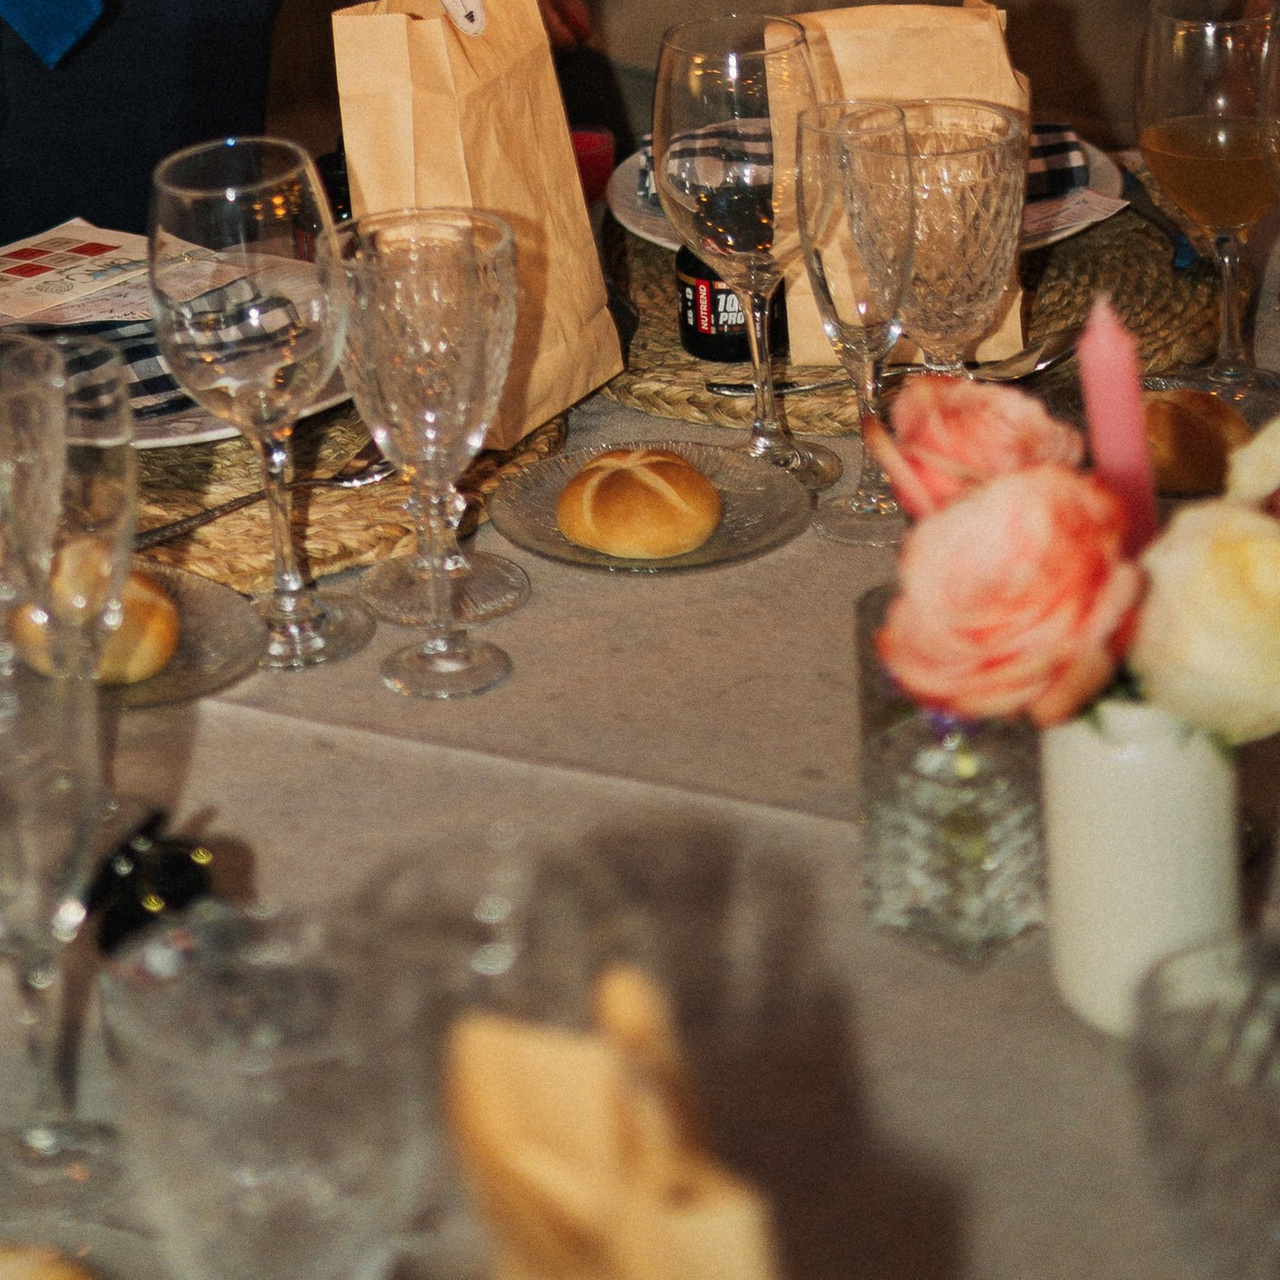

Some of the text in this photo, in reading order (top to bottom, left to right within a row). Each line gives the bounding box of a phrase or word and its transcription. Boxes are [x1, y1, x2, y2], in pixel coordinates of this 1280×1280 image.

[698, 284, 709, 331] NUTREND
[717, 293, 743, 312] 10
[718, 312, 745, 325] PRO
